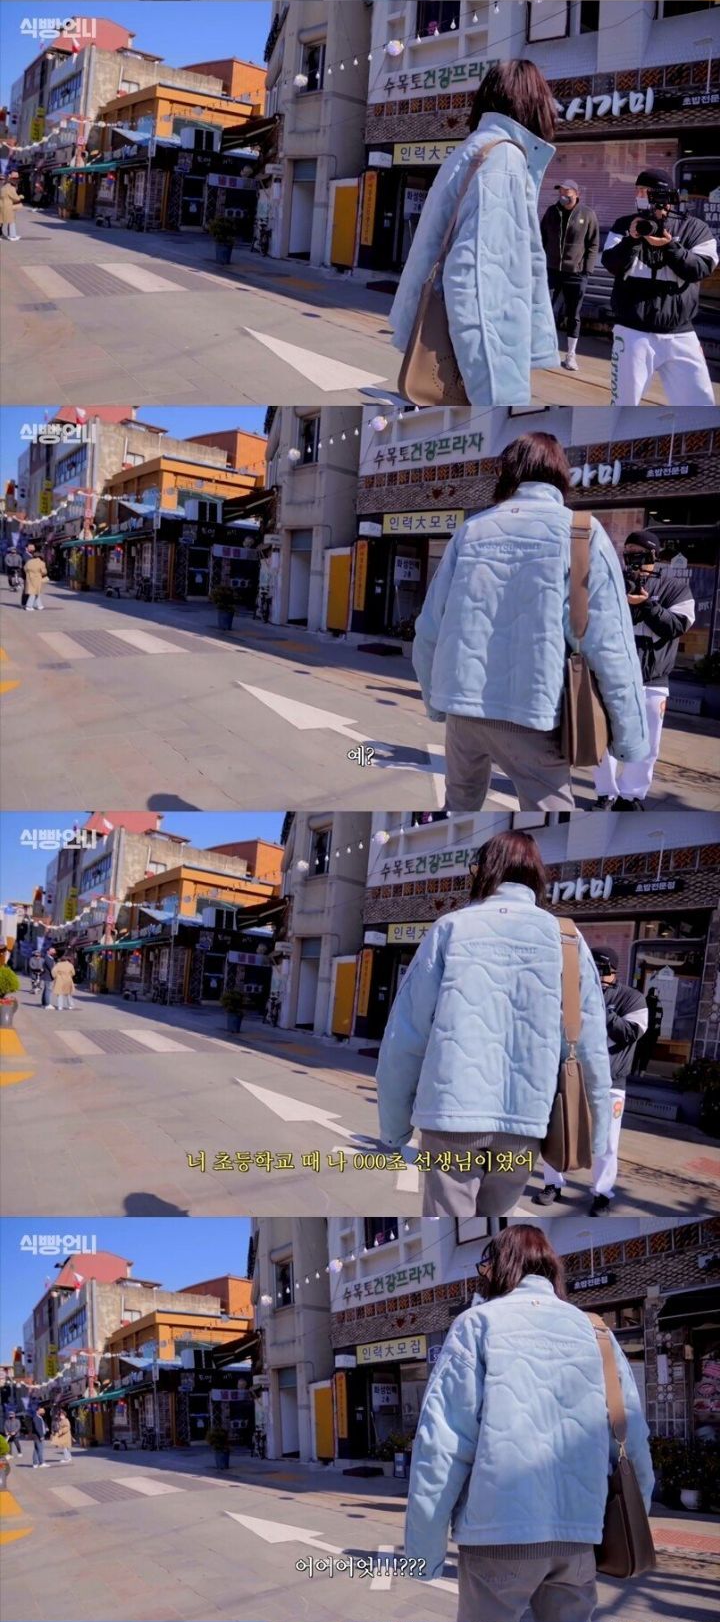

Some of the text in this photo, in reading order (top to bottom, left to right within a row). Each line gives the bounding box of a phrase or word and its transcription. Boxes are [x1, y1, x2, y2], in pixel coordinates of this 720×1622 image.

[374, 432, 483, 469] 수목토건강프라자
[646, 465, 690, 479] 초밥전문점
[389, 513, 457, 530] 인력大모집
[635, 881, 677, 893] 초밥전문점
[343, 1261, 436, 1302] 수목토건강프라자
[574, 1274, 609, 1290] 초밥전문점
[362, 1339, 421, 1361] 인력大모집
